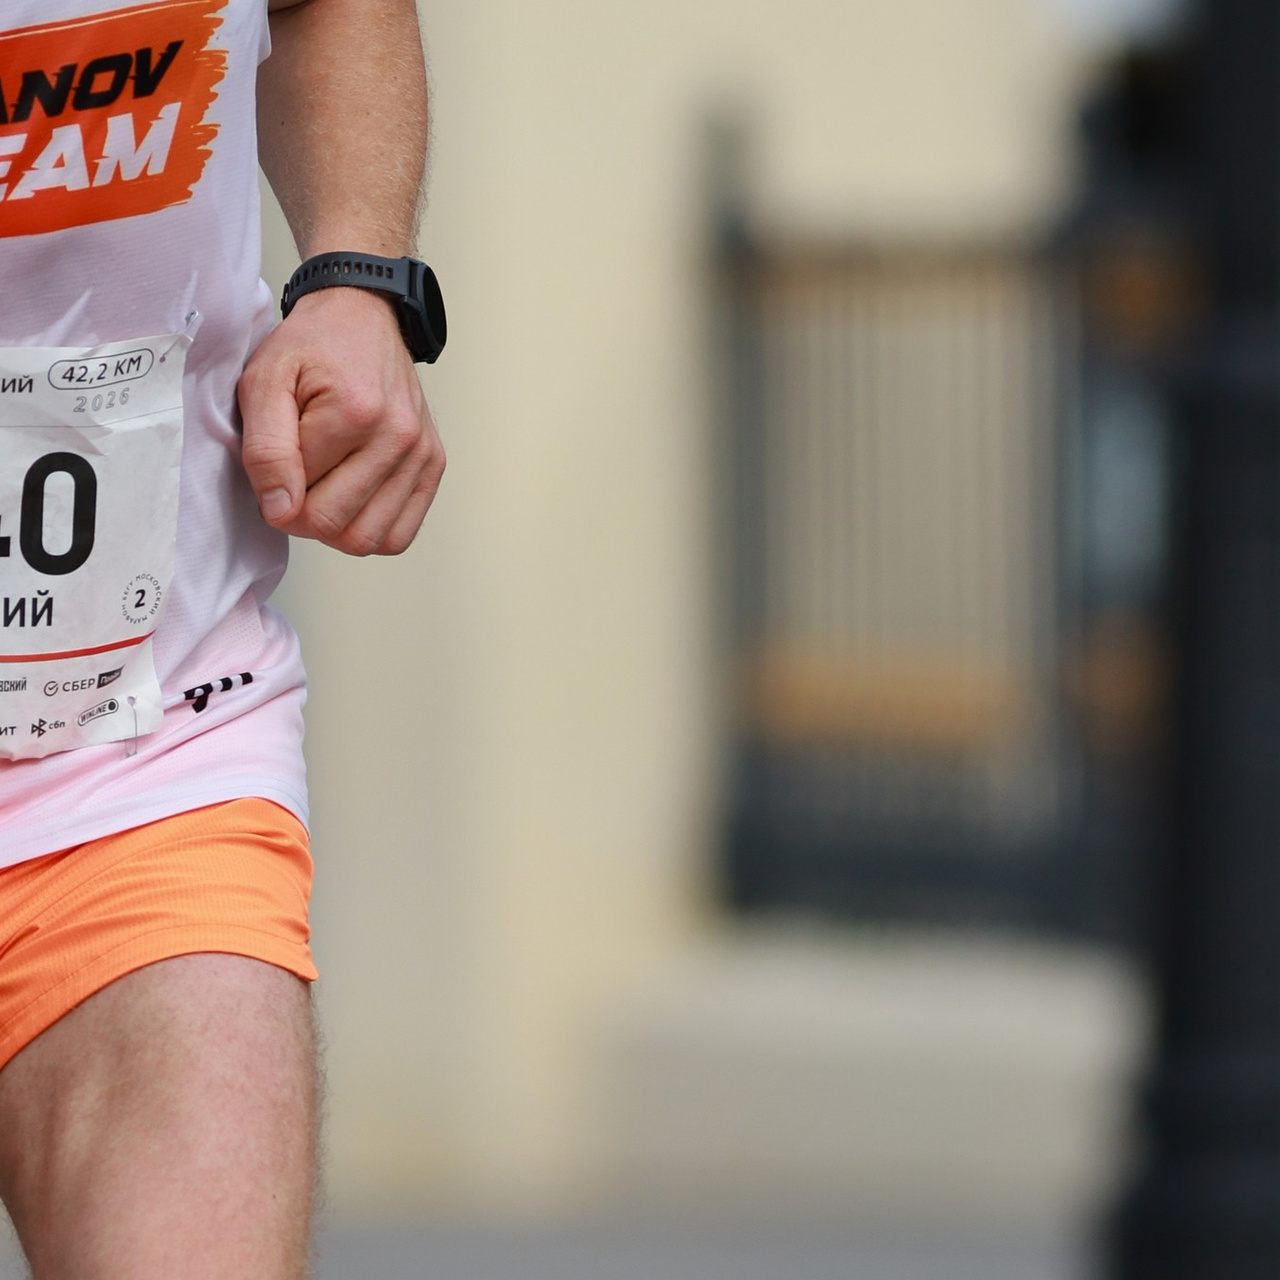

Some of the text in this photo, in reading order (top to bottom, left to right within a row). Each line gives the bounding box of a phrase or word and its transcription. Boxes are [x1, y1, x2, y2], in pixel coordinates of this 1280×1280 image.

[61, 362, 108, 385] 42,2
[73, 387, 130, 413] 2026
[134, 588, 146, 609] 2
[62, 679, 96, 693] СБЕР
[81, 704, 107, 723] WINLINE
[48, 721, 66, 729] сбп
